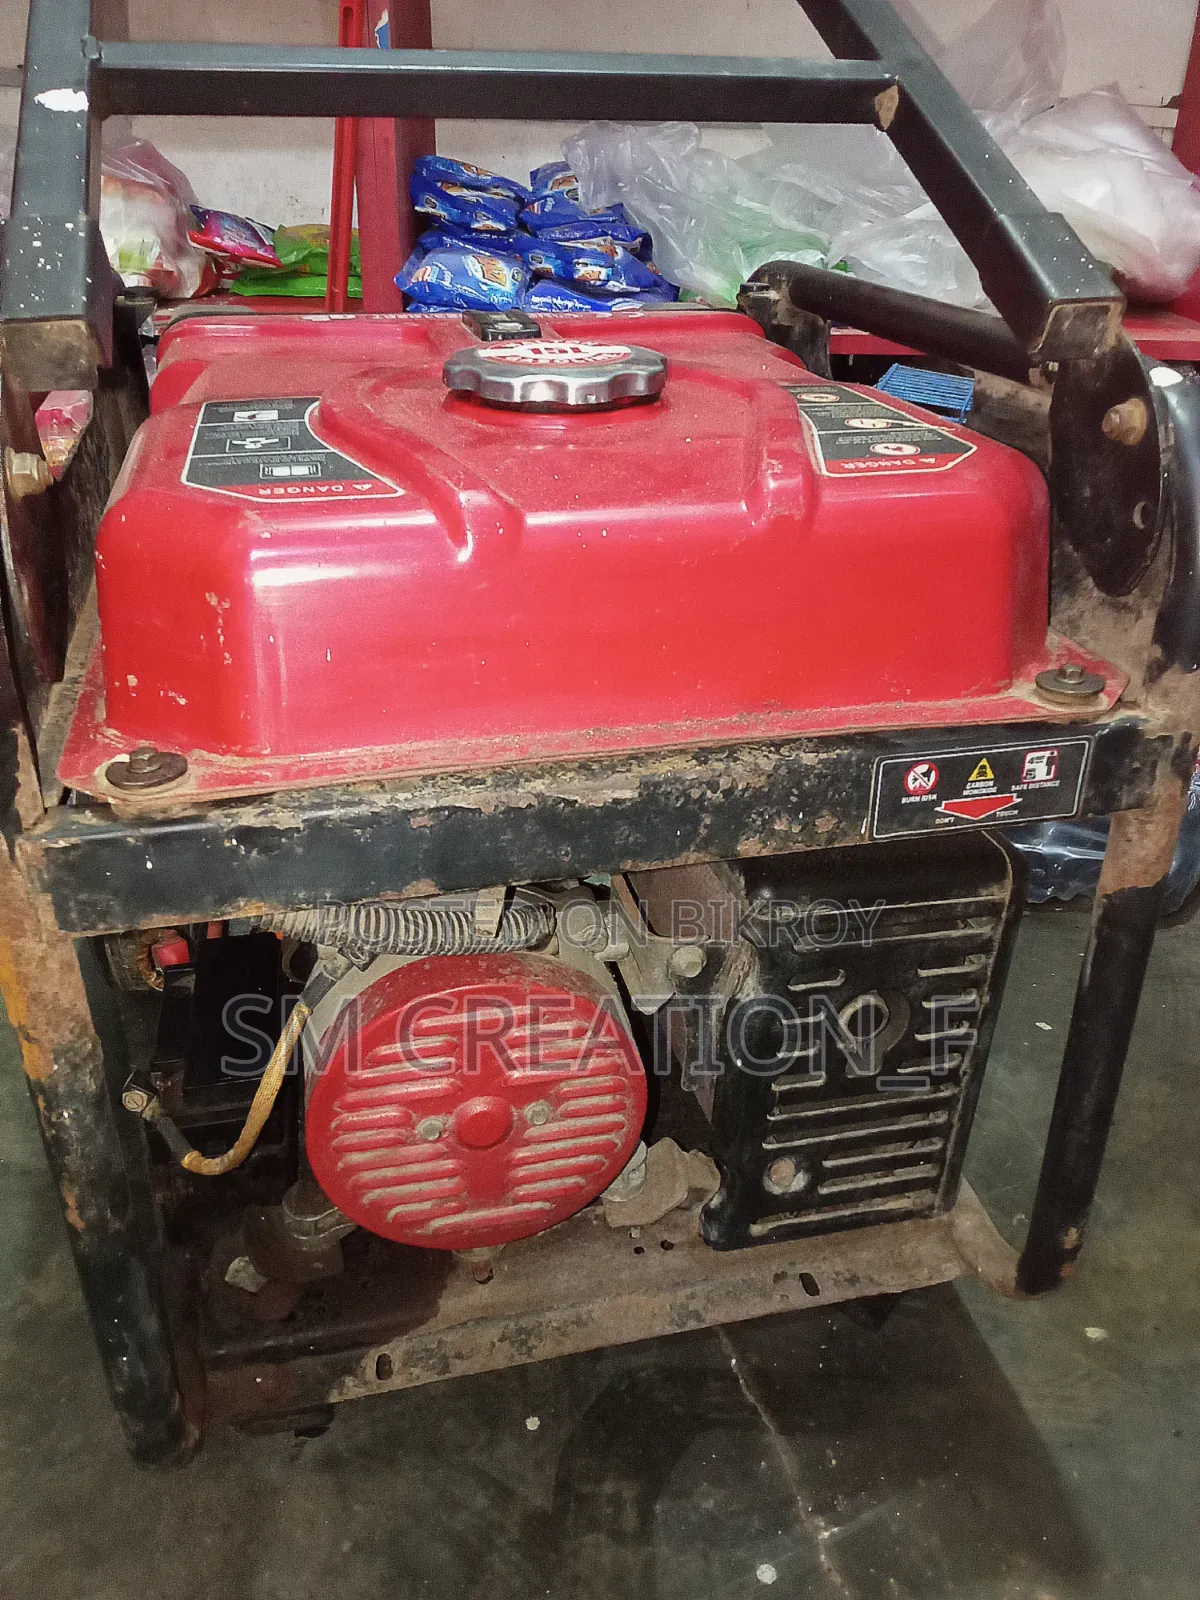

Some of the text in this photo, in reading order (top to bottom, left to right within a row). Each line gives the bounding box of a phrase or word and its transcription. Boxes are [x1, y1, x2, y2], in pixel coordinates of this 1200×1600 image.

[840, 459, 916, 469] DANGER
[258, 485, 344, 495] DANGER
[965, 781, 994, 789] CARBON
[1011, 780, 1060, 792] SAFE DISTANCE
[901, 793, 938, 804] BURN RISK
[935, 810, 1019, 825] DON'T TOUCH
